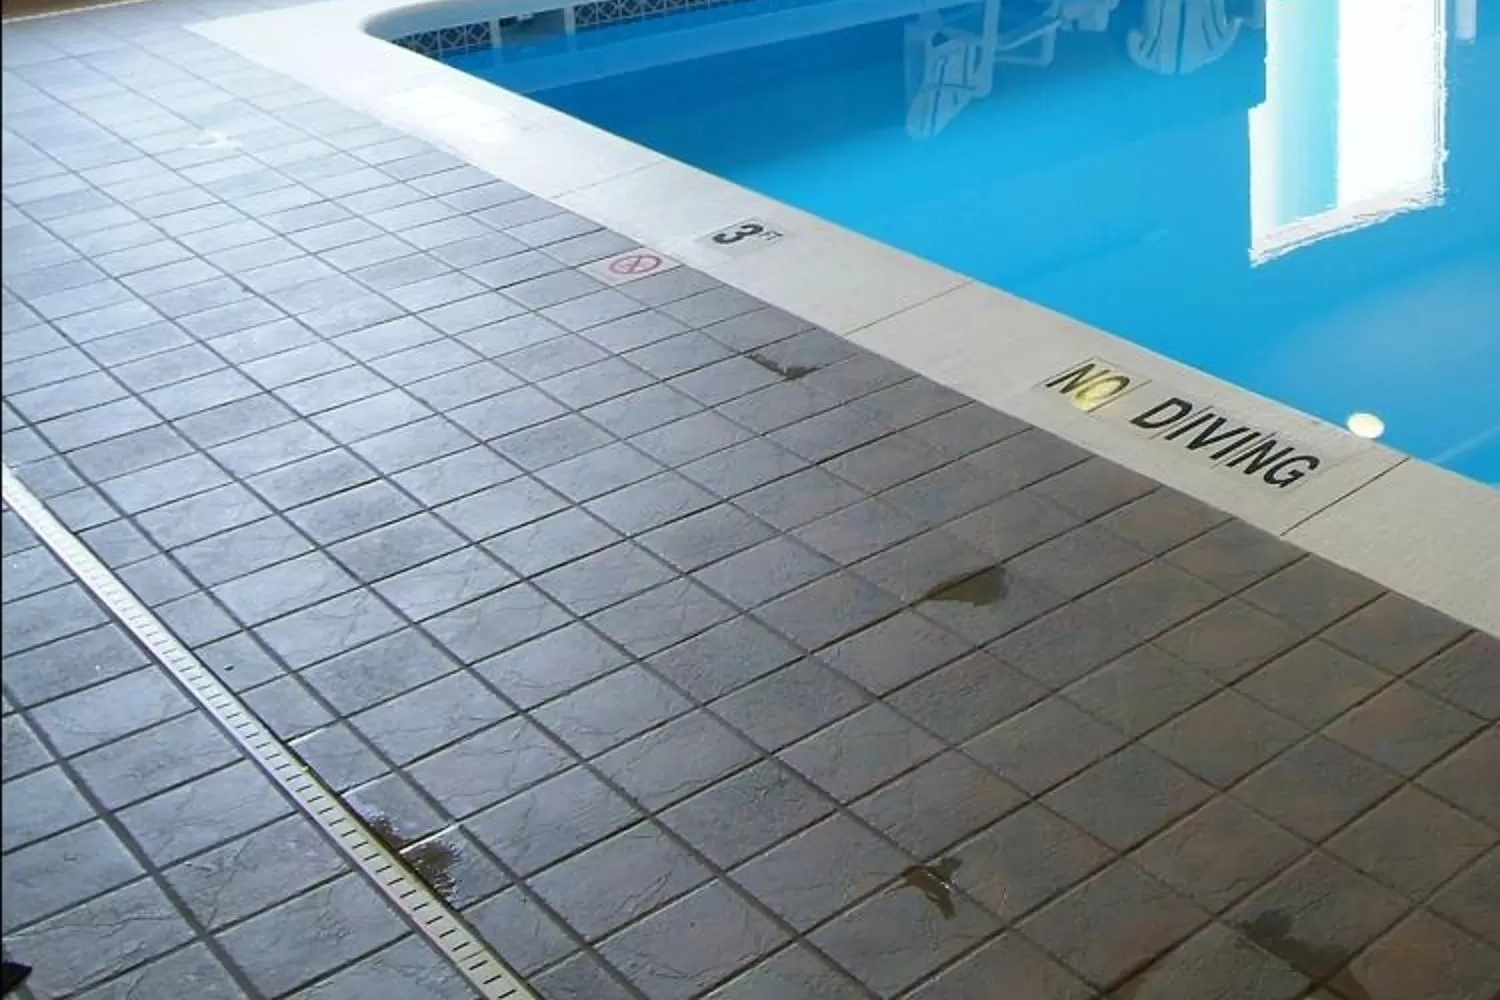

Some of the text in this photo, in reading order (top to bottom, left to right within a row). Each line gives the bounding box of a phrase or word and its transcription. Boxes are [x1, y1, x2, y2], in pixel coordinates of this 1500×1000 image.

[712, 223, 764, 245] 3
[1045, 363, 1321, 489] NO DIVING
